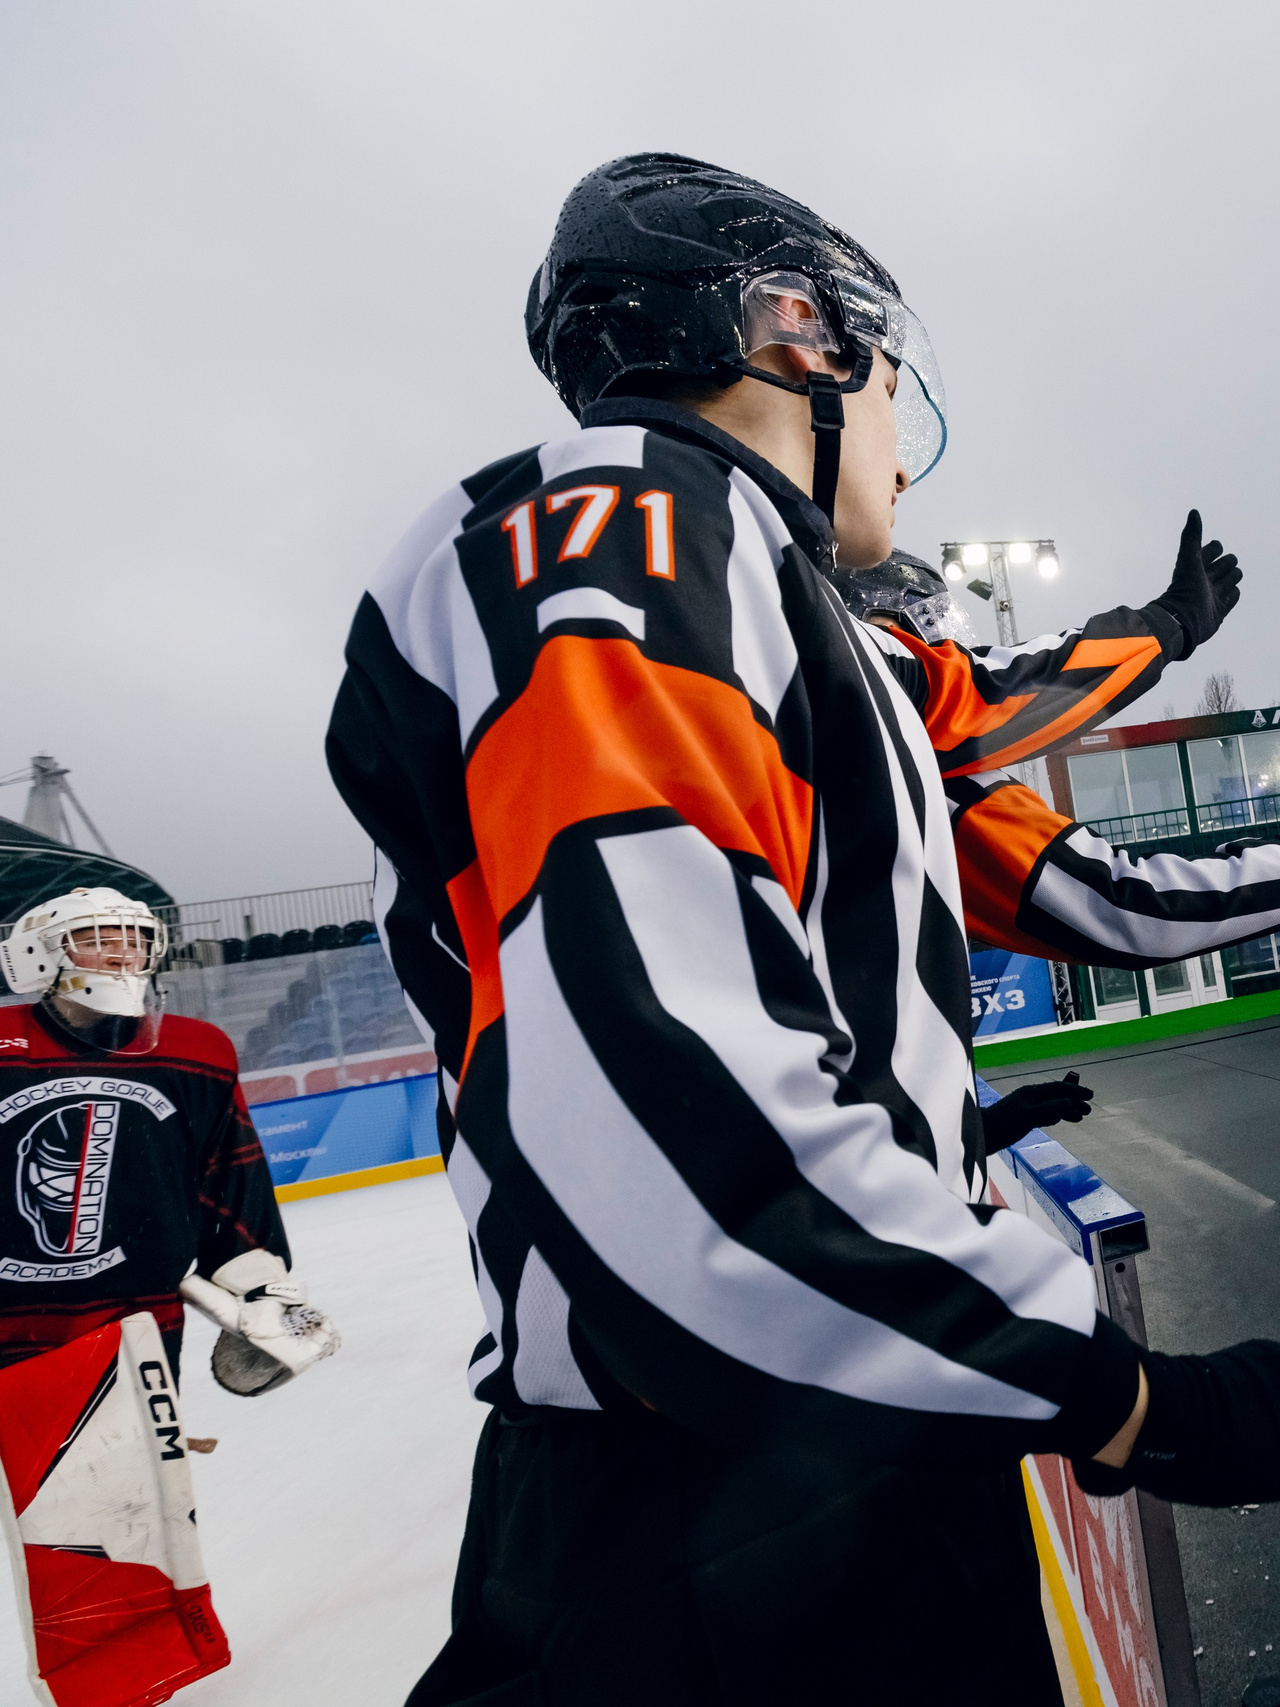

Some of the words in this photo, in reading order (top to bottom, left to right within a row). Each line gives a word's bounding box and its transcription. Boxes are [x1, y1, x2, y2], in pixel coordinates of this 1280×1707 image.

[500, 484, 676, 590] 171
[0, 1080, 92, 1118] HOCKEY
[100, 1080, 170, 1116] GOALIE
[73, 1103, 117, 1254] DOMINATION
[0, 1252, 116, 1279] ACADEMY
[139, 1360, 185, 1461] CCM
